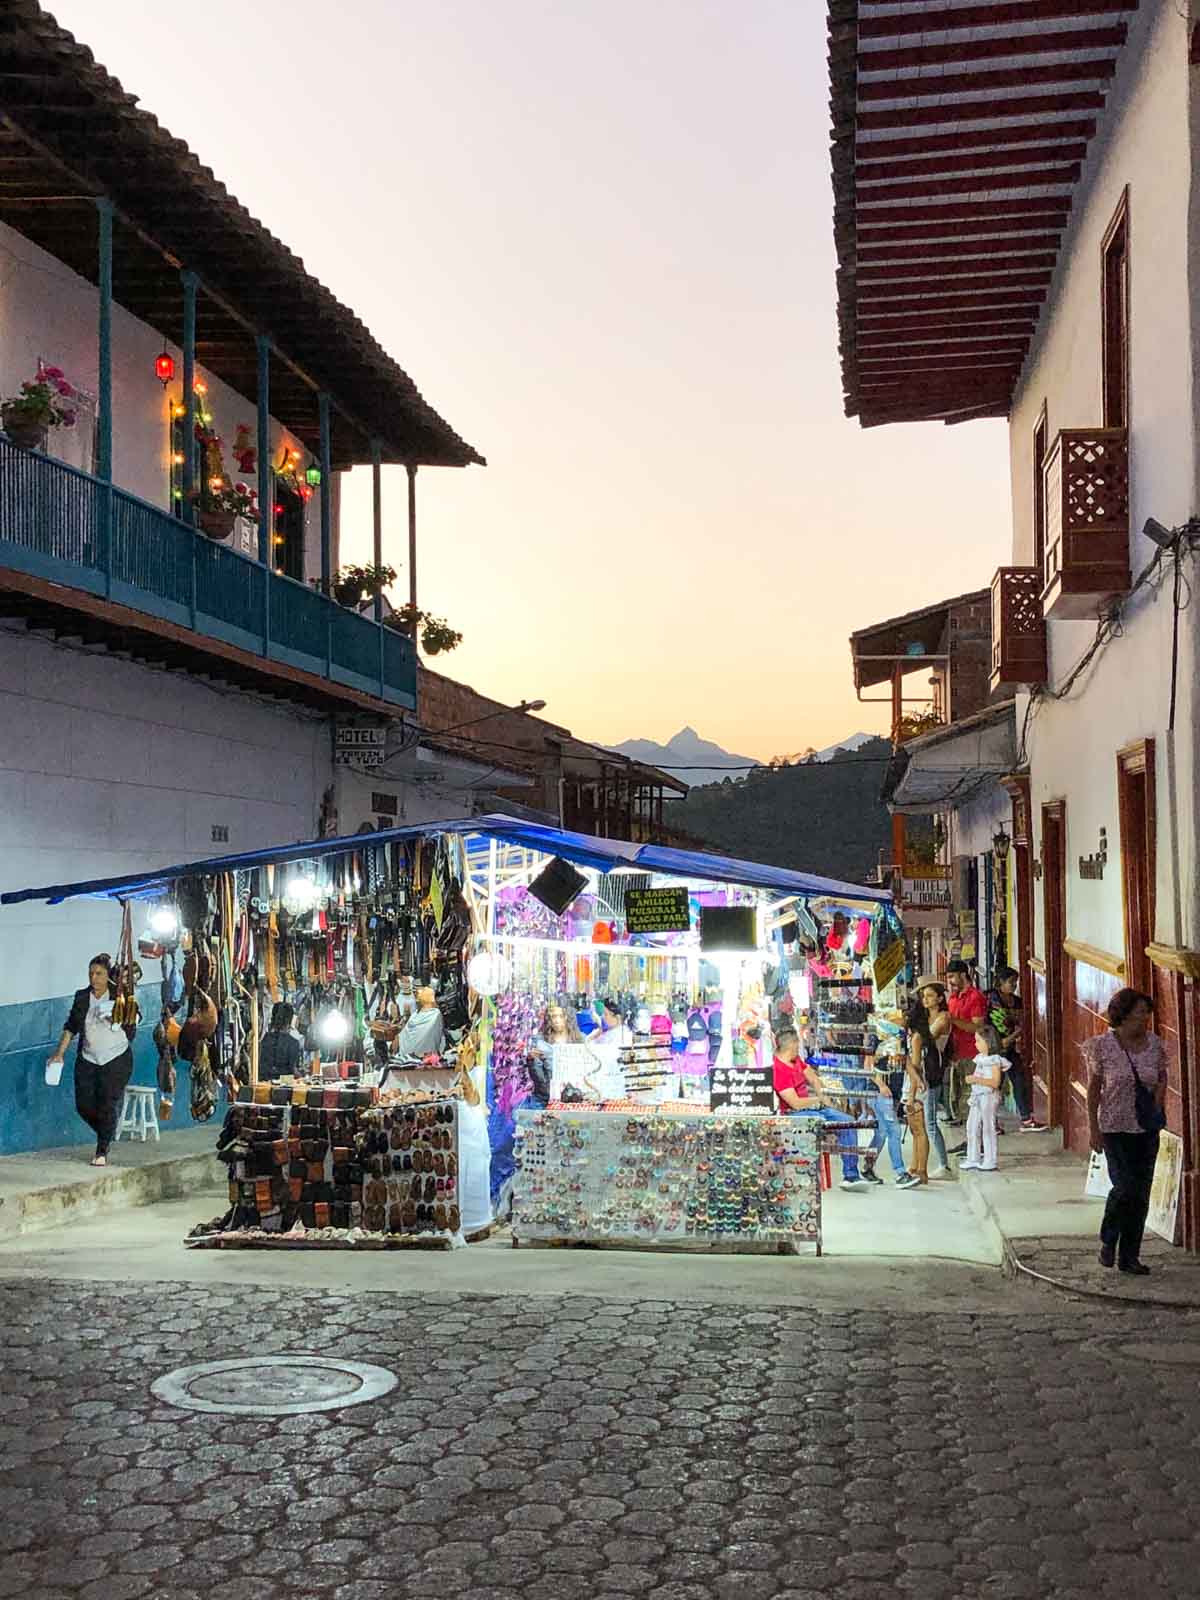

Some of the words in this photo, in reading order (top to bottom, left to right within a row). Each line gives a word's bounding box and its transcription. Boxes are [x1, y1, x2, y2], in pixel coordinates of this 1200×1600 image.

[337, 730, 376, 743] HOTEL
[636, 897, 677, 907] ANILLOS
[630, 906, 677, 915] PULSERAS
[713, 1070, 726, 1081] Se
